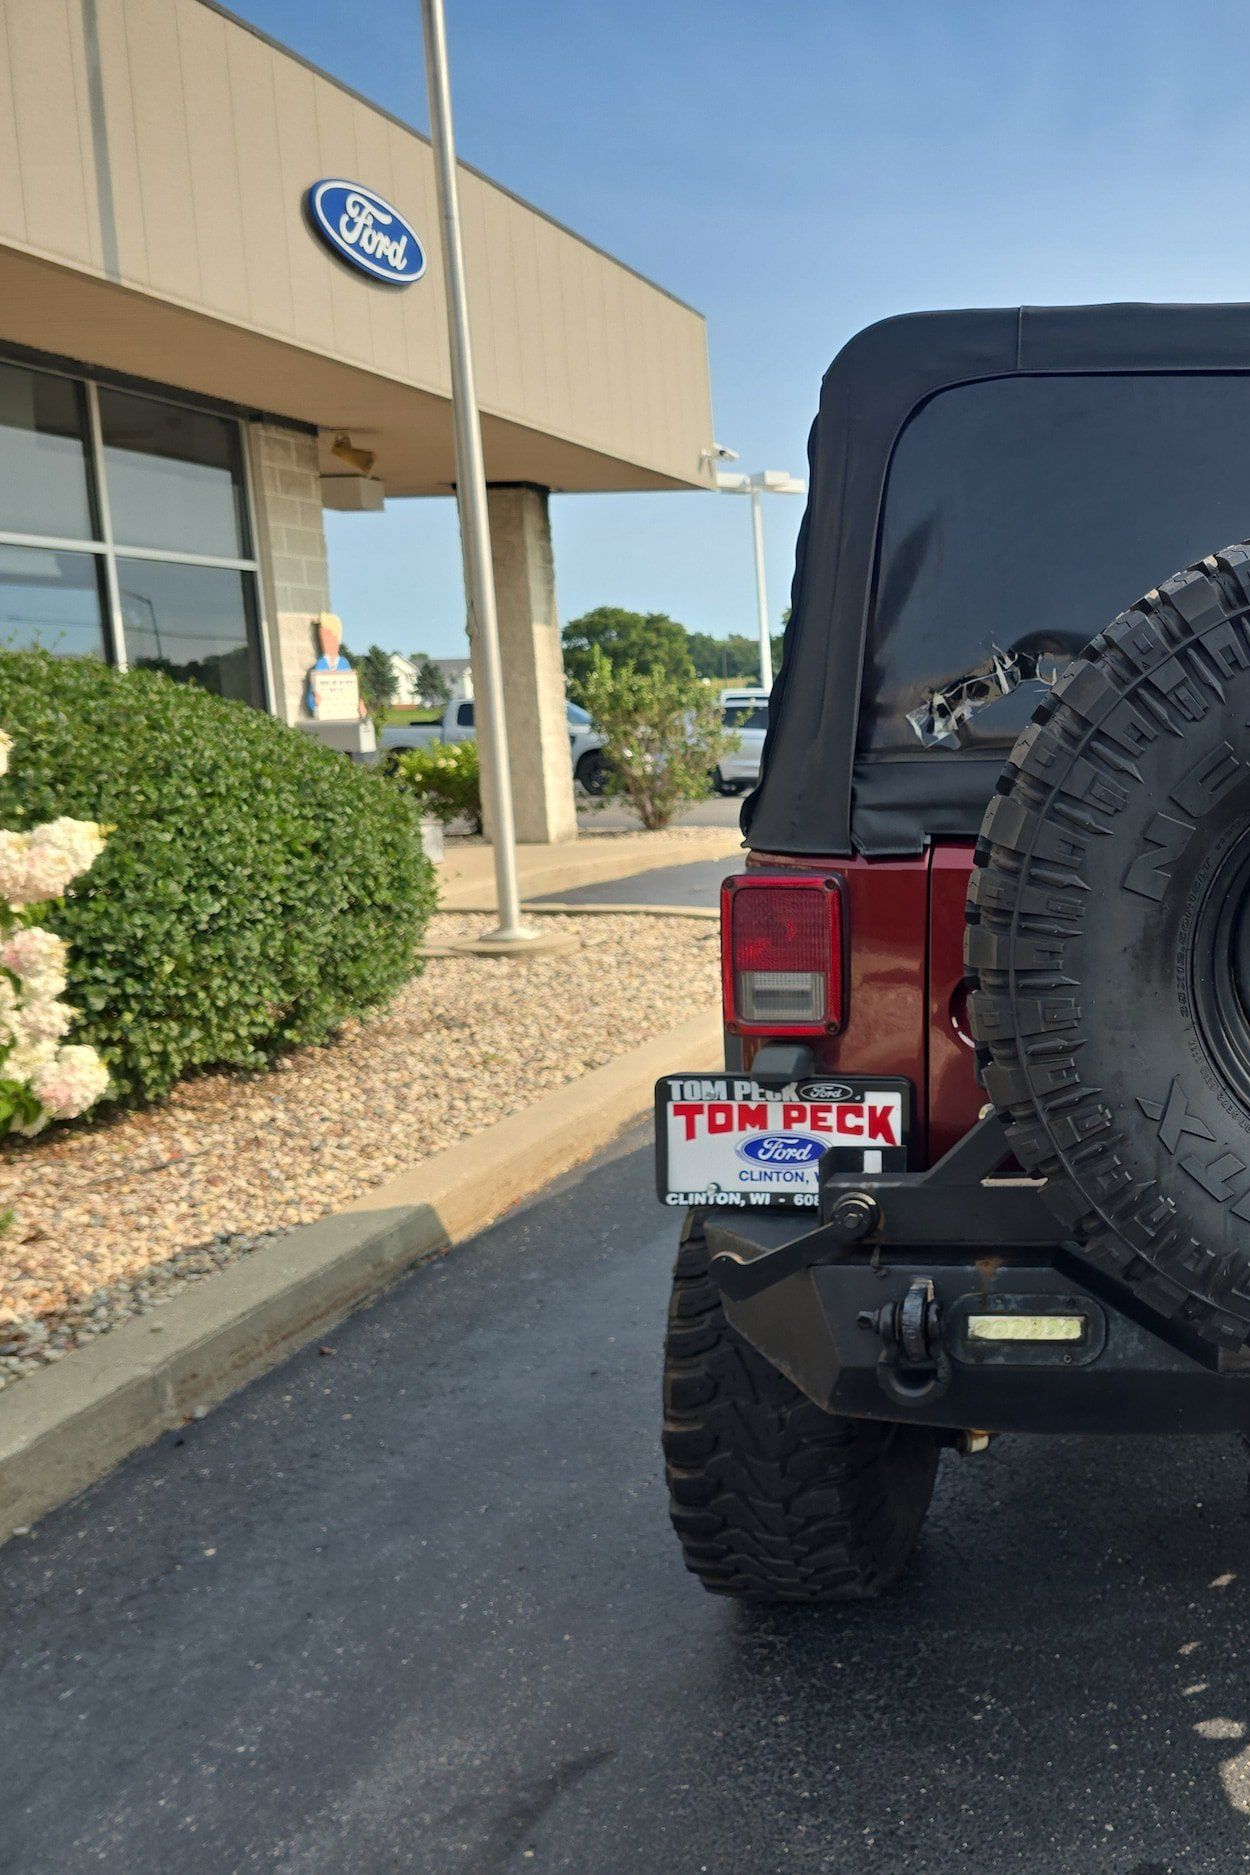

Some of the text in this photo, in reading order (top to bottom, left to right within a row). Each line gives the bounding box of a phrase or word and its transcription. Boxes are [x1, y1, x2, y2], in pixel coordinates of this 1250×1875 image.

[339, 192, 409, 271] Ford
[667, 1079, 728, 1102] TOM
[809, 1085, 843, 1099] Ford
[673, 1103, 897, 1147] TOM PECK
[757, 1136, 812, 1163] Ford
[739, 1169, 809, 1186] CLINTON,
[665, 1191, 746, 1208] CLINTON,
[749, 1192, 771, 1206] WI
